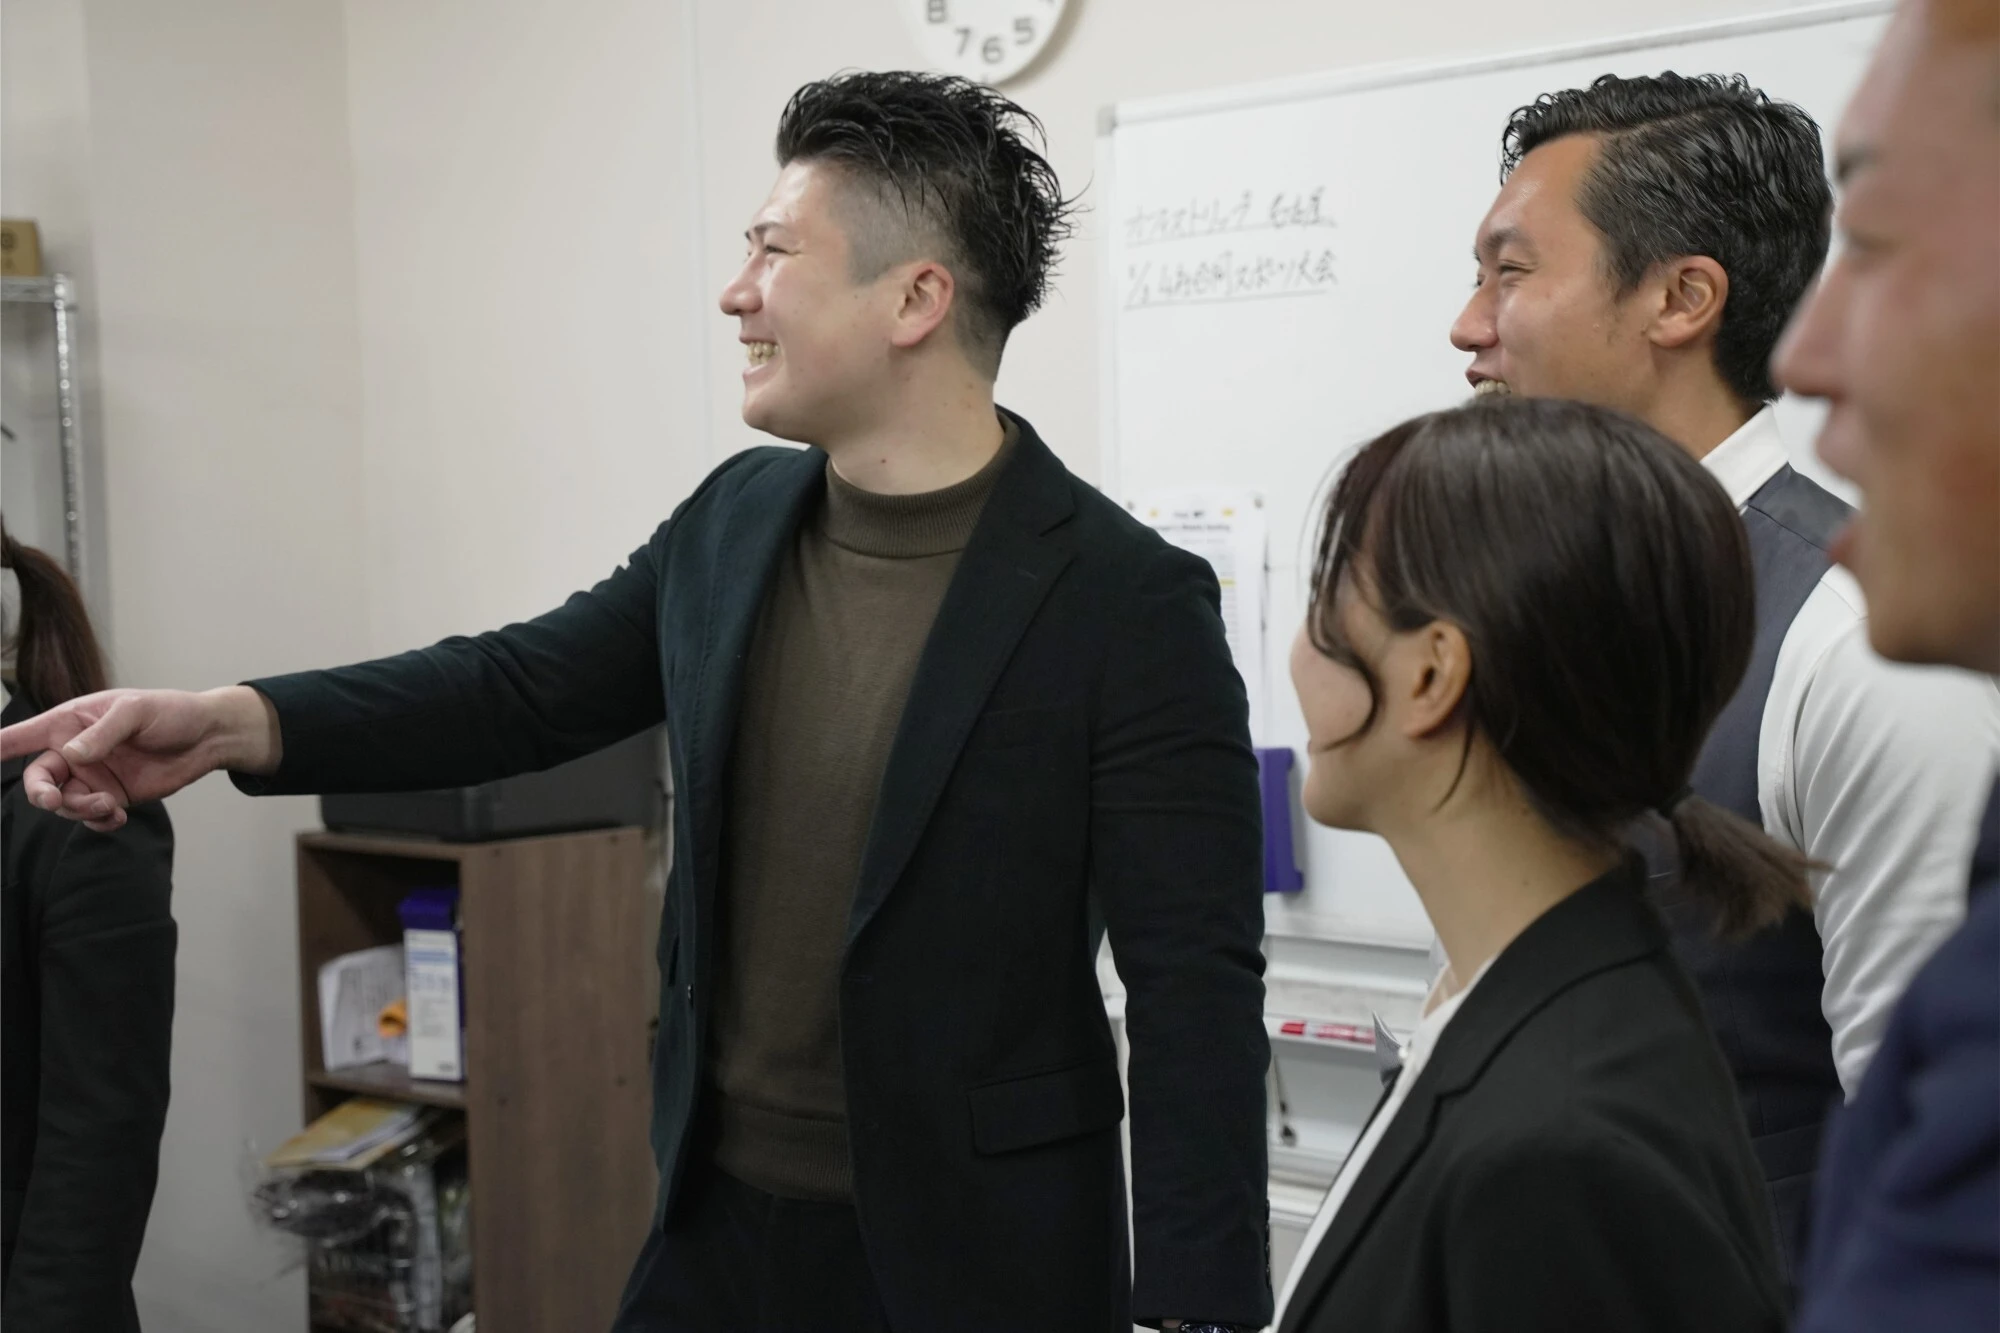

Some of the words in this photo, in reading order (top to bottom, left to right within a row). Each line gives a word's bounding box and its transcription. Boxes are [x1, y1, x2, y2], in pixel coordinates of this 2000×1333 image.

[954, 27, 972, 56] 7
[1014, 17, 1034, 45] 5
[982, 36, 1002, 64] 6
